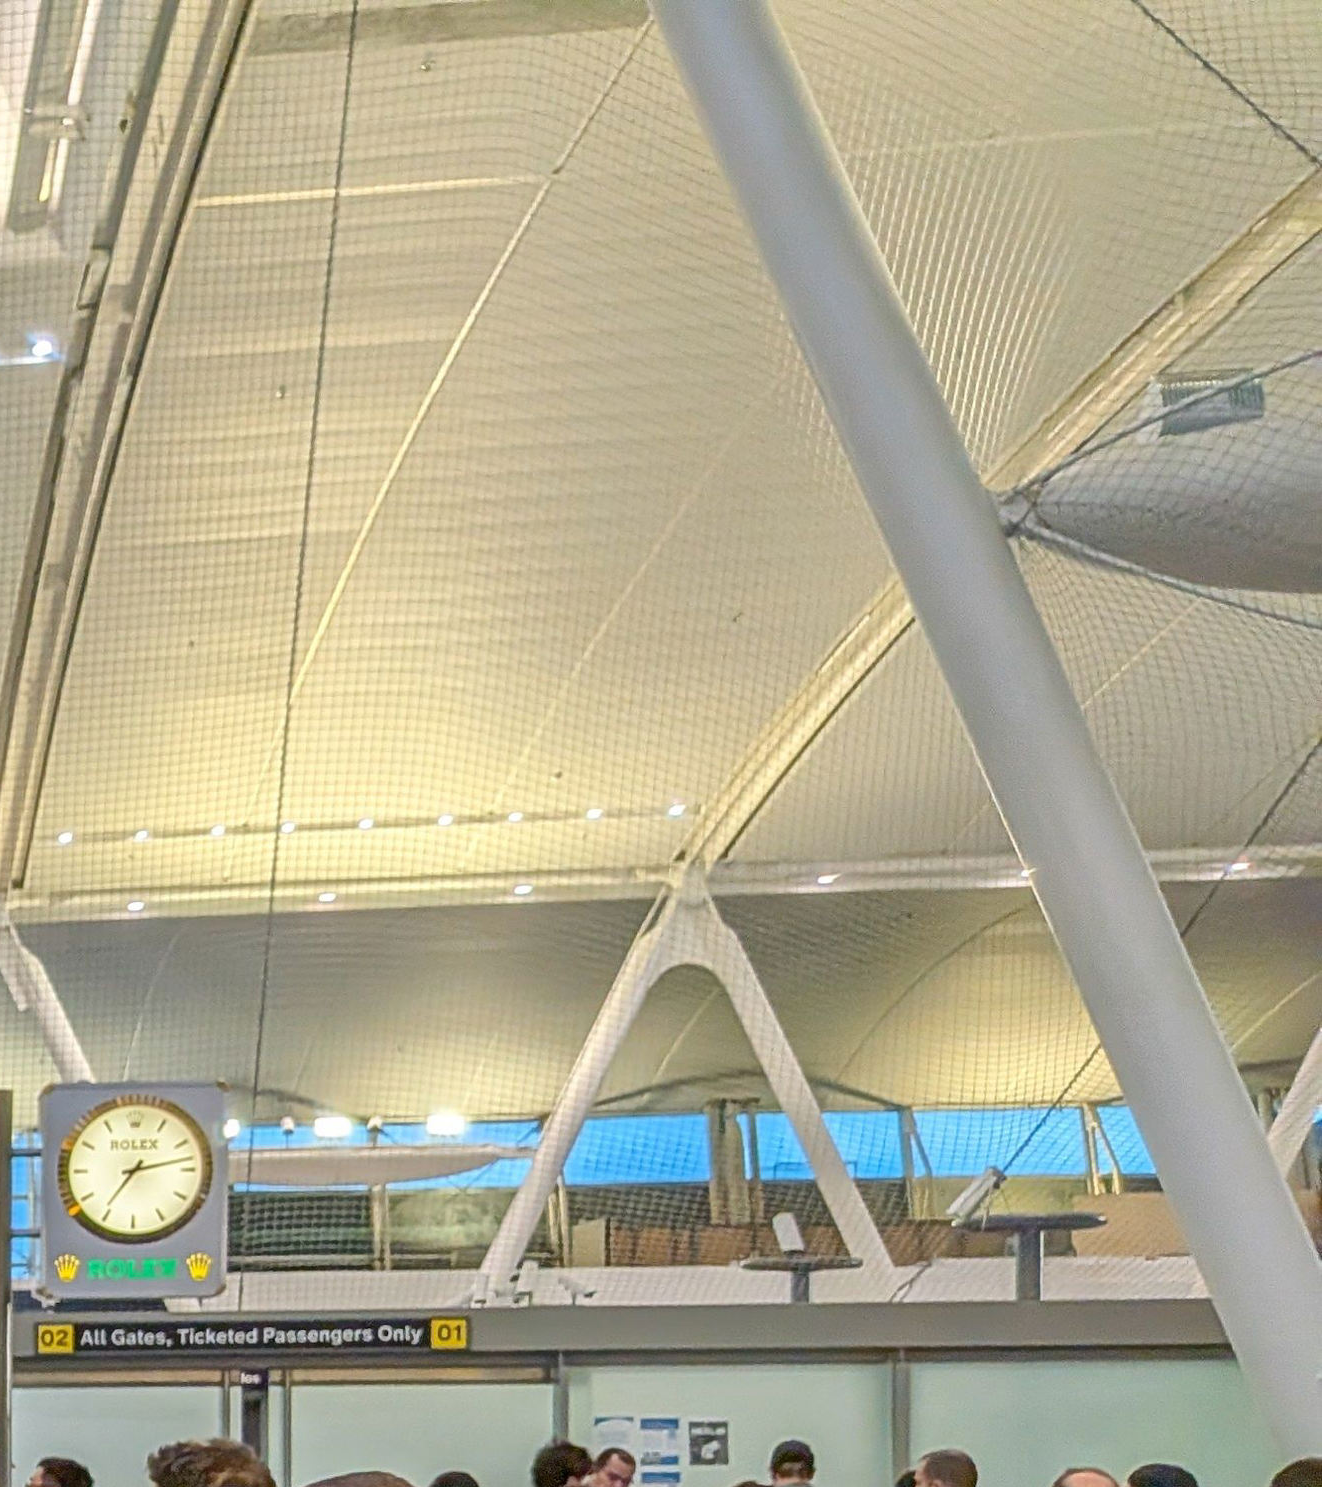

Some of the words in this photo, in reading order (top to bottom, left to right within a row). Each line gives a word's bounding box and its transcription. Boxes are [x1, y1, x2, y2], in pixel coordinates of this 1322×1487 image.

[110, 1138, 158, 1151] ROLEX
[87, 1257, 178, 1280] ROLEX
[41, 1329, 69, 1347] 02
[80, 1328, 106, 1347] All
[111, 1328, 173, 1347] Gates,
[177, 1327, 257, 1346] Ticketed
[263, 1326, 373, 1346] Passengers
[377, 1324, 424, 1345] Only
[438, 1324, 461, 1341] 01
